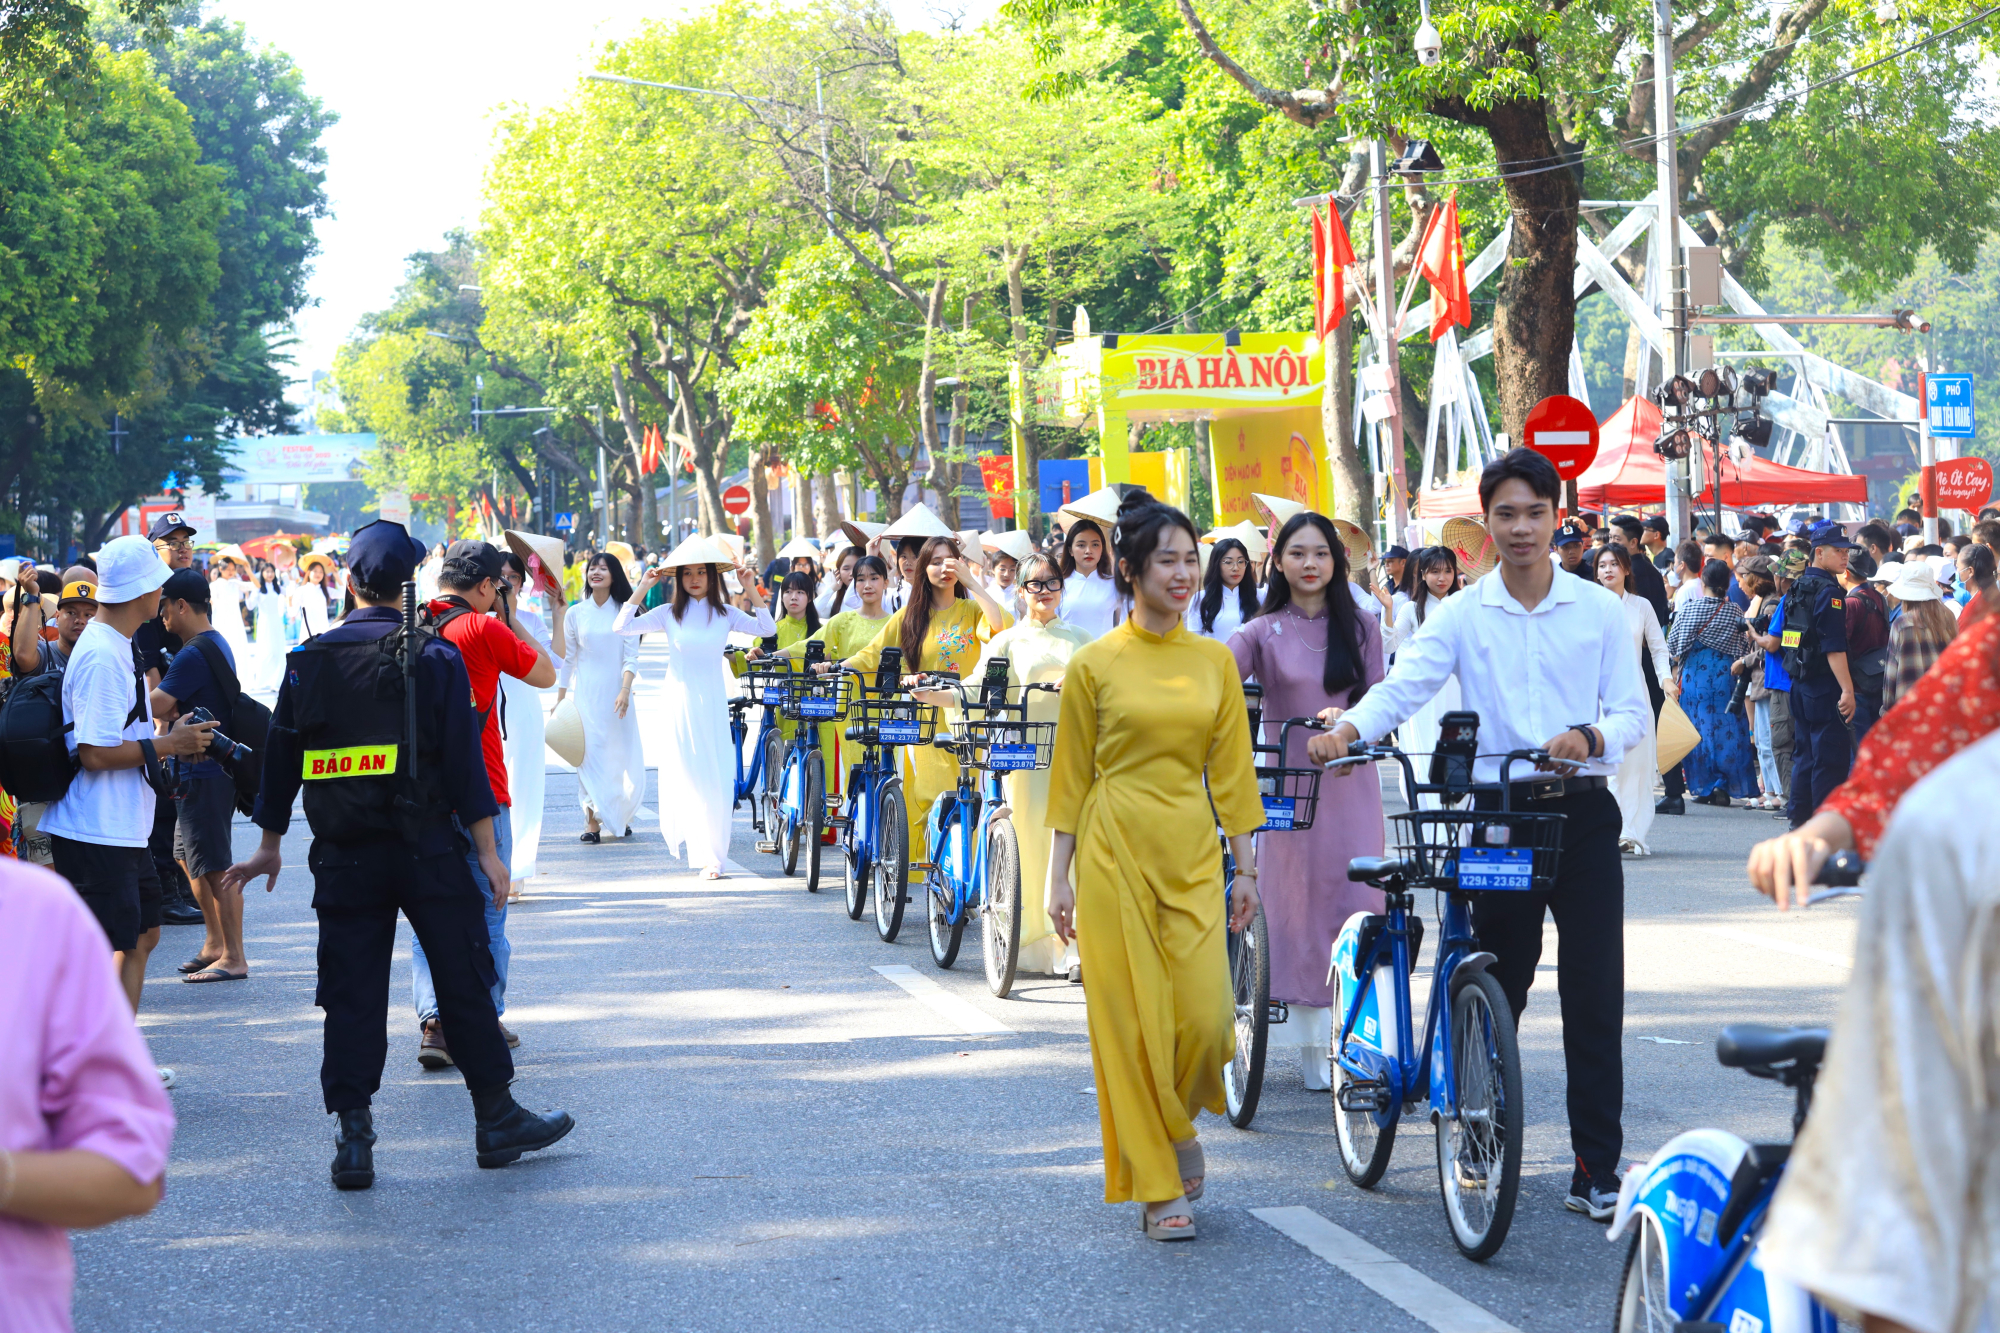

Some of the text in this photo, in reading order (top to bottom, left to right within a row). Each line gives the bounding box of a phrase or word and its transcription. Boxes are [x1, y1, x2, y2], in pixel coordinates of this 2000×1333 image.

[1137, 348, 1310, 395] BIA HÀ NỘI
[1945, 380, 1961, 396] PHỐ
[1965, 471, 1990, 492] Cay,
[312, 752, 386, 775] BẢO AN
[1461, 875, 1529, 887] X29A-23.628
